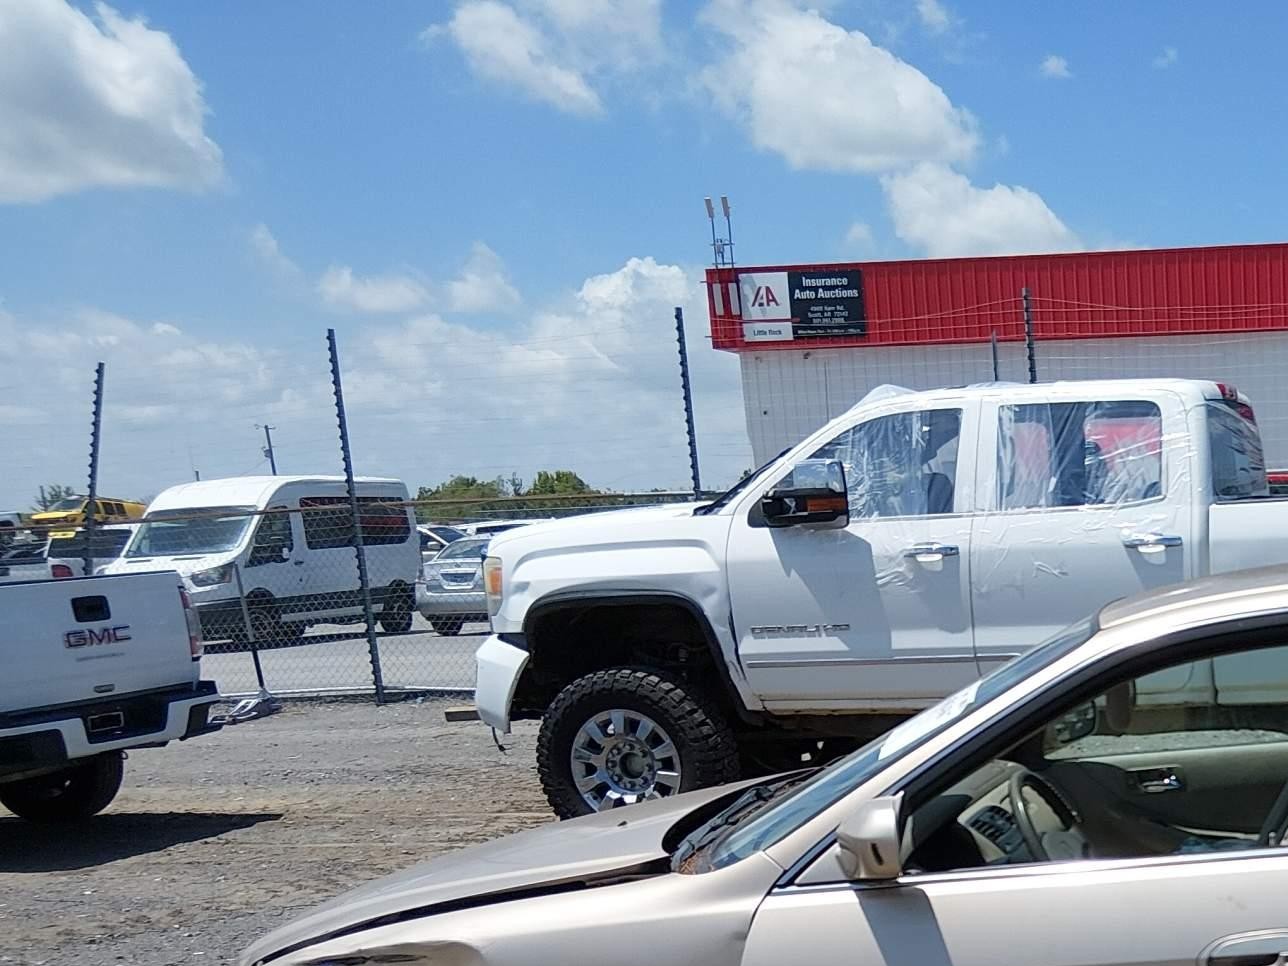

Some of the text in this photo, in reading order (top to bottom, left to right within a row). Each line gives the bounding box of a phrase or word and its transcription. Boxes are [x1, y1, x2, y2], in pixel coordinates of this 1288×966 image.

[794, 287, 859, 300] Auto Auctions
[63, 624, 132, 649] GMC
